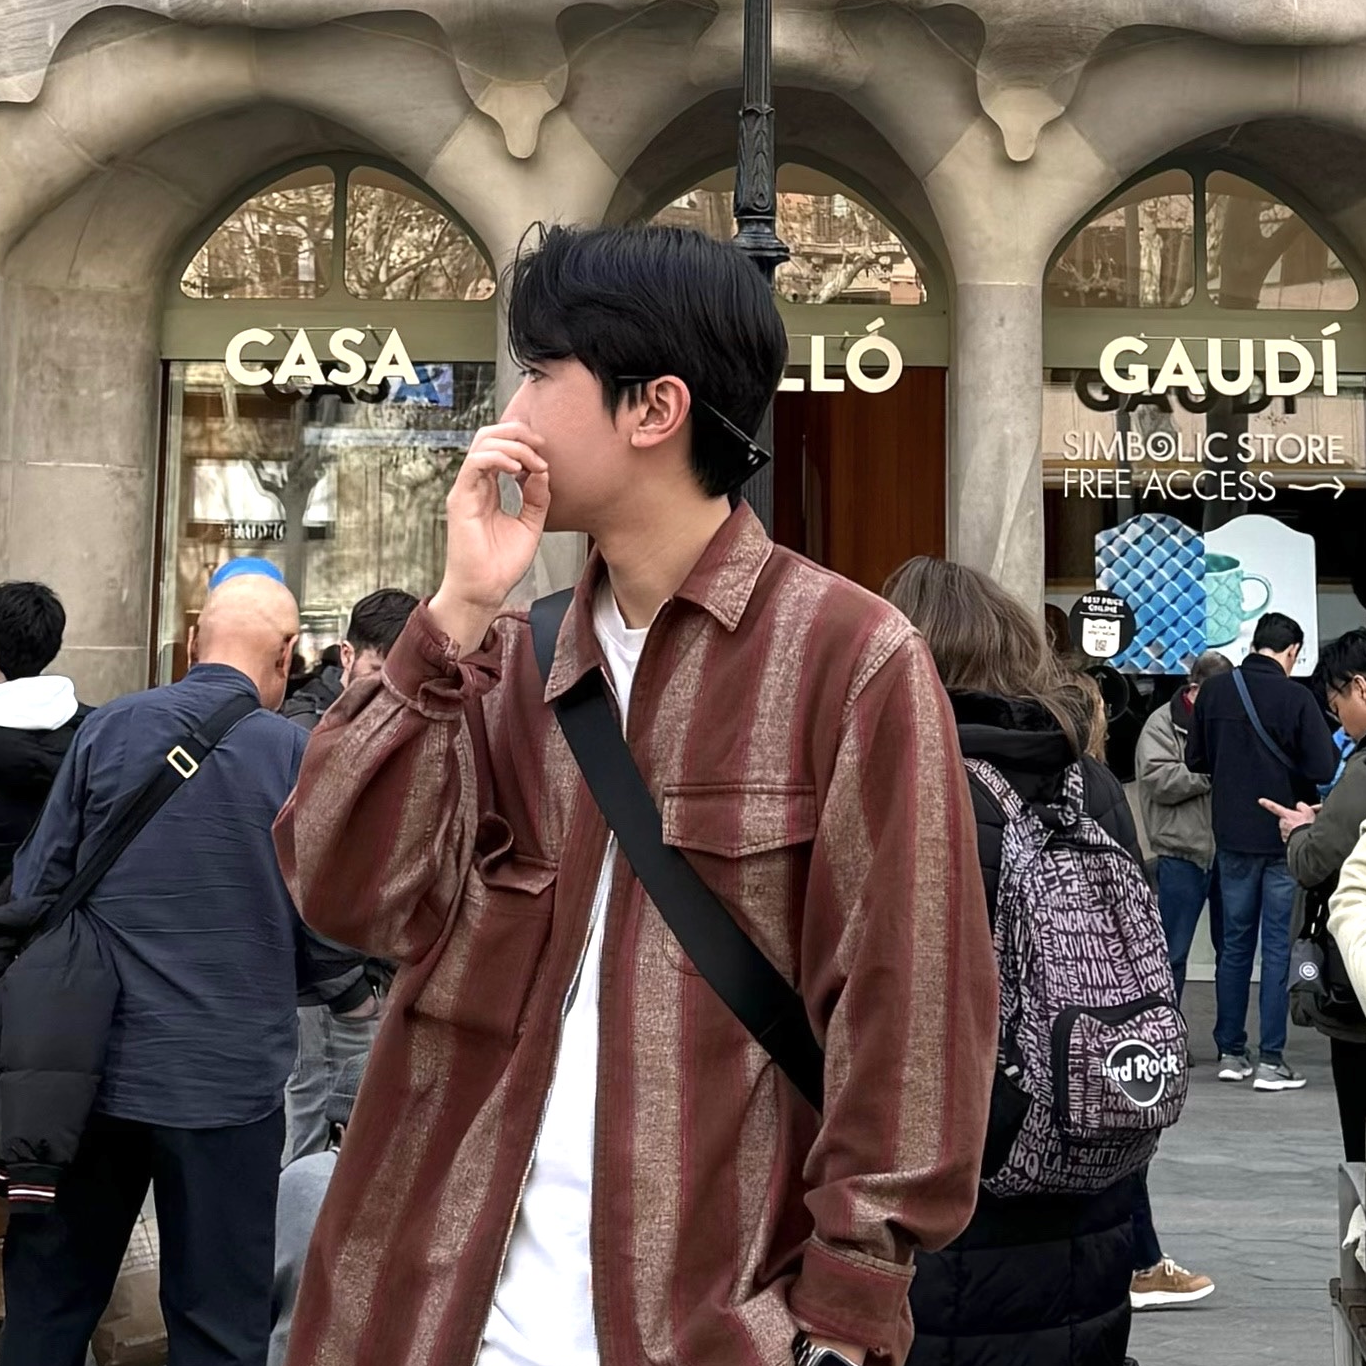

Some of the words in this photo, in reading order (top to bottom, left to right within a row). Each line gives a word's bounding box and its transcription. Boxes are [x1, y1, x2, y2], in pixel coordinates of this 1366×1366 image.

[225, 327, 420, 386] CASA
[1099, 321, 1341, 397] GAUDÍ
[1062, 430, 1229, 464] SIMBOLIC
[1236, 432, 1346, 465] STORE
[1064, 468, 1133, 499] FREE
[1142, 469, 1277, 502] ACCESS
[1134, 1048, 1180, 1083] Rock
